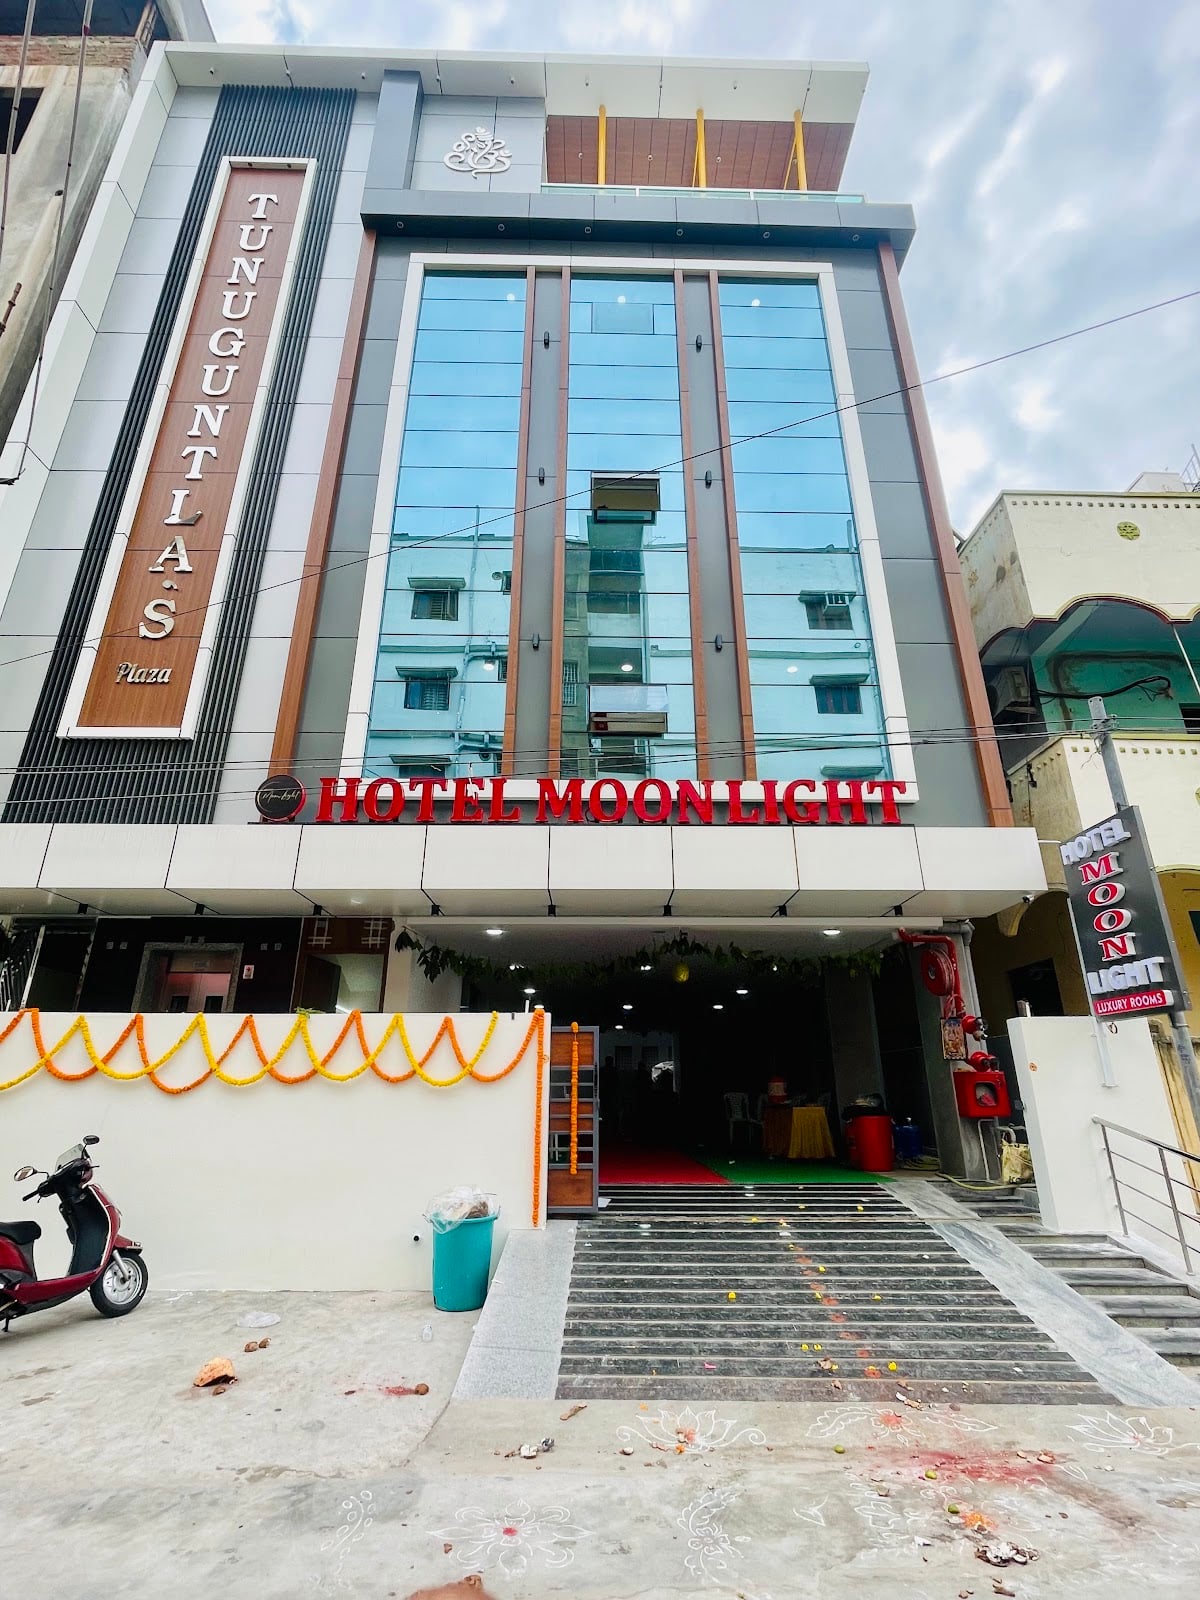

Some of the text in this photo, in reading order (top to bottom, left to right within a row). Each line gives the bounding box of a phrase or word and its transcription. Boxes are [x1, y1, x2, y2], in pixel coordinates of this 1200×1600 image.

[115, 661, 172, 684] Plaza
[315, 777, 907, 825] HOTEL MOONLIGHT
[1060, 819, 1131, 865] HOTEL
[1079, 852, 1135, 961] MOON
[1087, 957, 1165, 994] LIGHT
[1096, 992, 1163, 1014] LUXURY ROOMS
